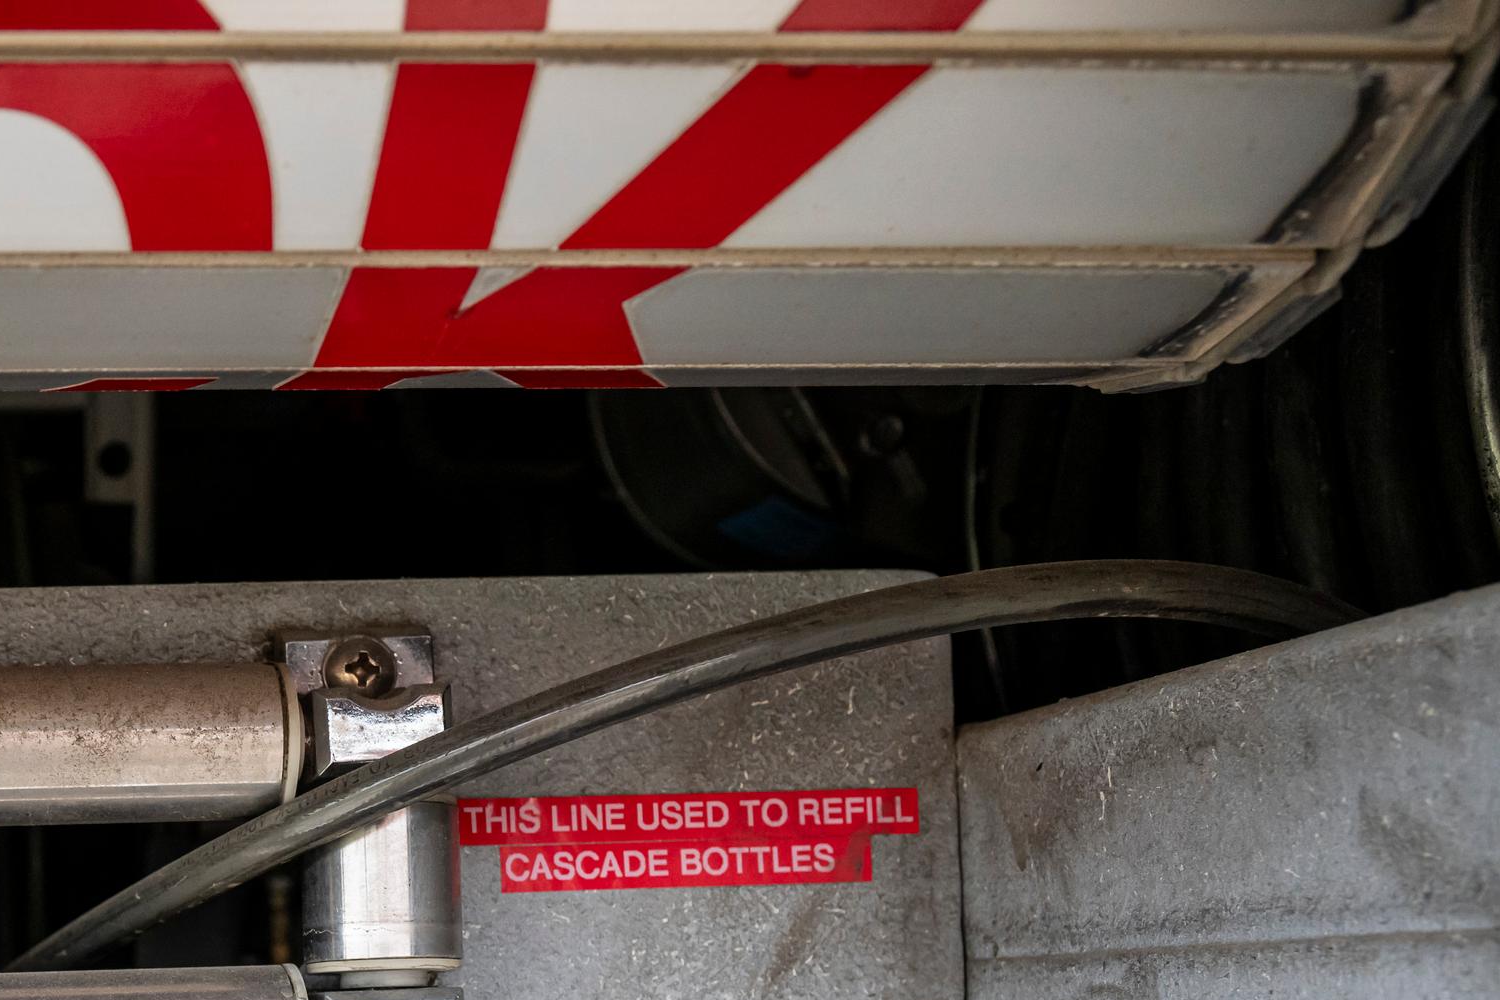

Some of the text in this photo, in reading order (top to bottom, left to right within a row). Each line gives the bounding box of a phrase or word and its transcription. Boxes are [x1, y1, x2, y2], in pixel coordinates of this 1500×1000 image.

[463, 796, 914, 834] THIS LINE USED TO REFILL
[505, 843, 836, 882] CASCADE BOTTLES
